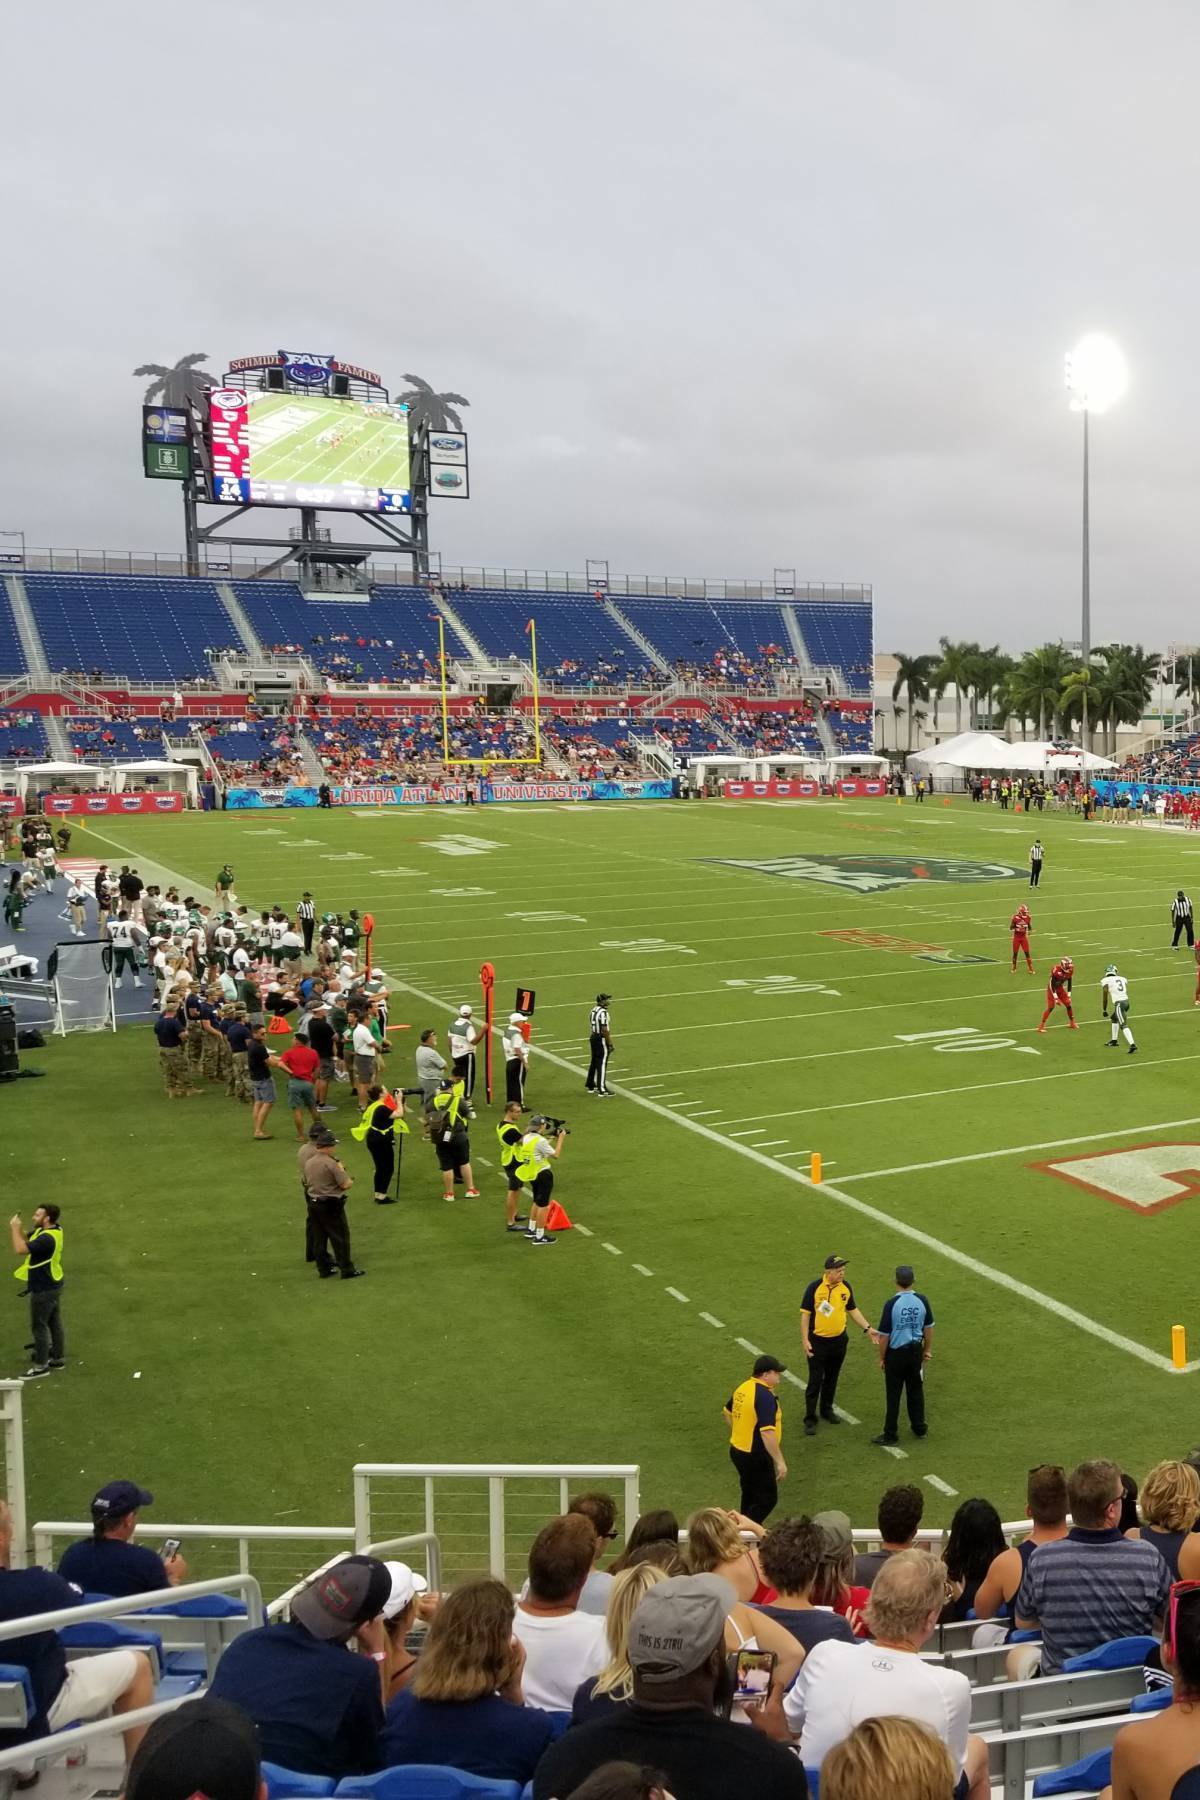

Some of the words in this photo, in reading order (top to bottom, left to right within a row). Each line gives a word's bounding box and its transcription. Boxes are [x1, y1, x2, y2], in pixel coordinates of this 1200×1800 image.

[231, 355, 281, 371] SCHMIDT
[286, 353, 330, 368] FAU
[336, 363, 381, 384] FAMILY
[330, 787, 396, 803] LORIDA
[402, 785, 479, 802] ATLANTI
[493, 784, 593, 800] UNIVERSITY
[112, 926, 127, 939] 74
[721, 975, 825, 996] 20
[1115, 979, 1124, 992] 3
[522, 991, 531, 1011] 1
[894, 1027, 1017, 1053] 10
[901, 1307, 919, 1317] CSC
[638, 1632, 652, 1648] THIS
[653, 1636, 661, 1649] IS
[661, 1638, 684, 1651] 2TRU
